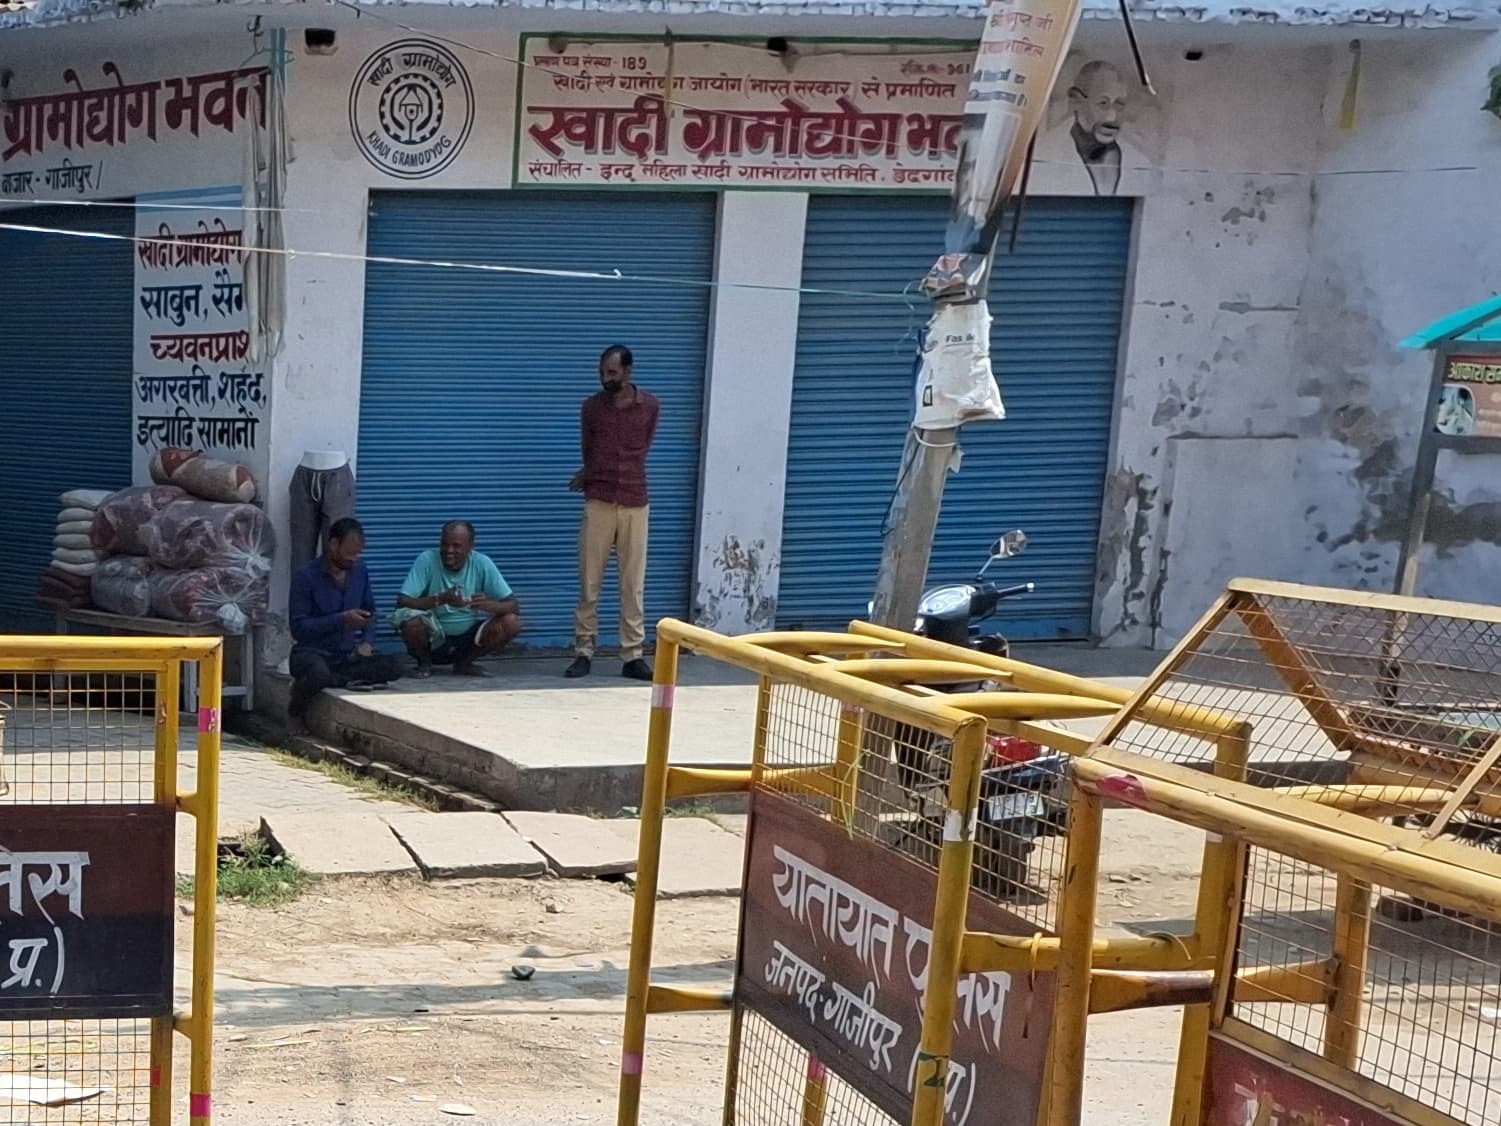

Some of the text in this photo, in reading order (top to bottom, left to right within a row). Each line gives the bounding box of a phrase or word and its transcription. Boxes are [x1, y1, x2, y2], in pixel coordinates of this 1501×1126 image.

[1, 61, 160, 161] ग्रामोद्योग
[553, 70, 591, 91] खादी
[862, 76, 880, 98] से
[885, 77, 956, 100] प्रमाणित
[367, 130, 452, 167] KHADI GRAMODYOG
[527, 93, 667, 160] खादी
[683, 97, 902, 162] ग्रामोद्योग
[528, 159, 582, 181] संचालित
[691, 159, 732, 180] खादी
[137, 406, 259, 451] इत्यादि सामानों
[772, 845, 899, 991] यातायात
[824, 981, 903, 1074] गाजीपुर
